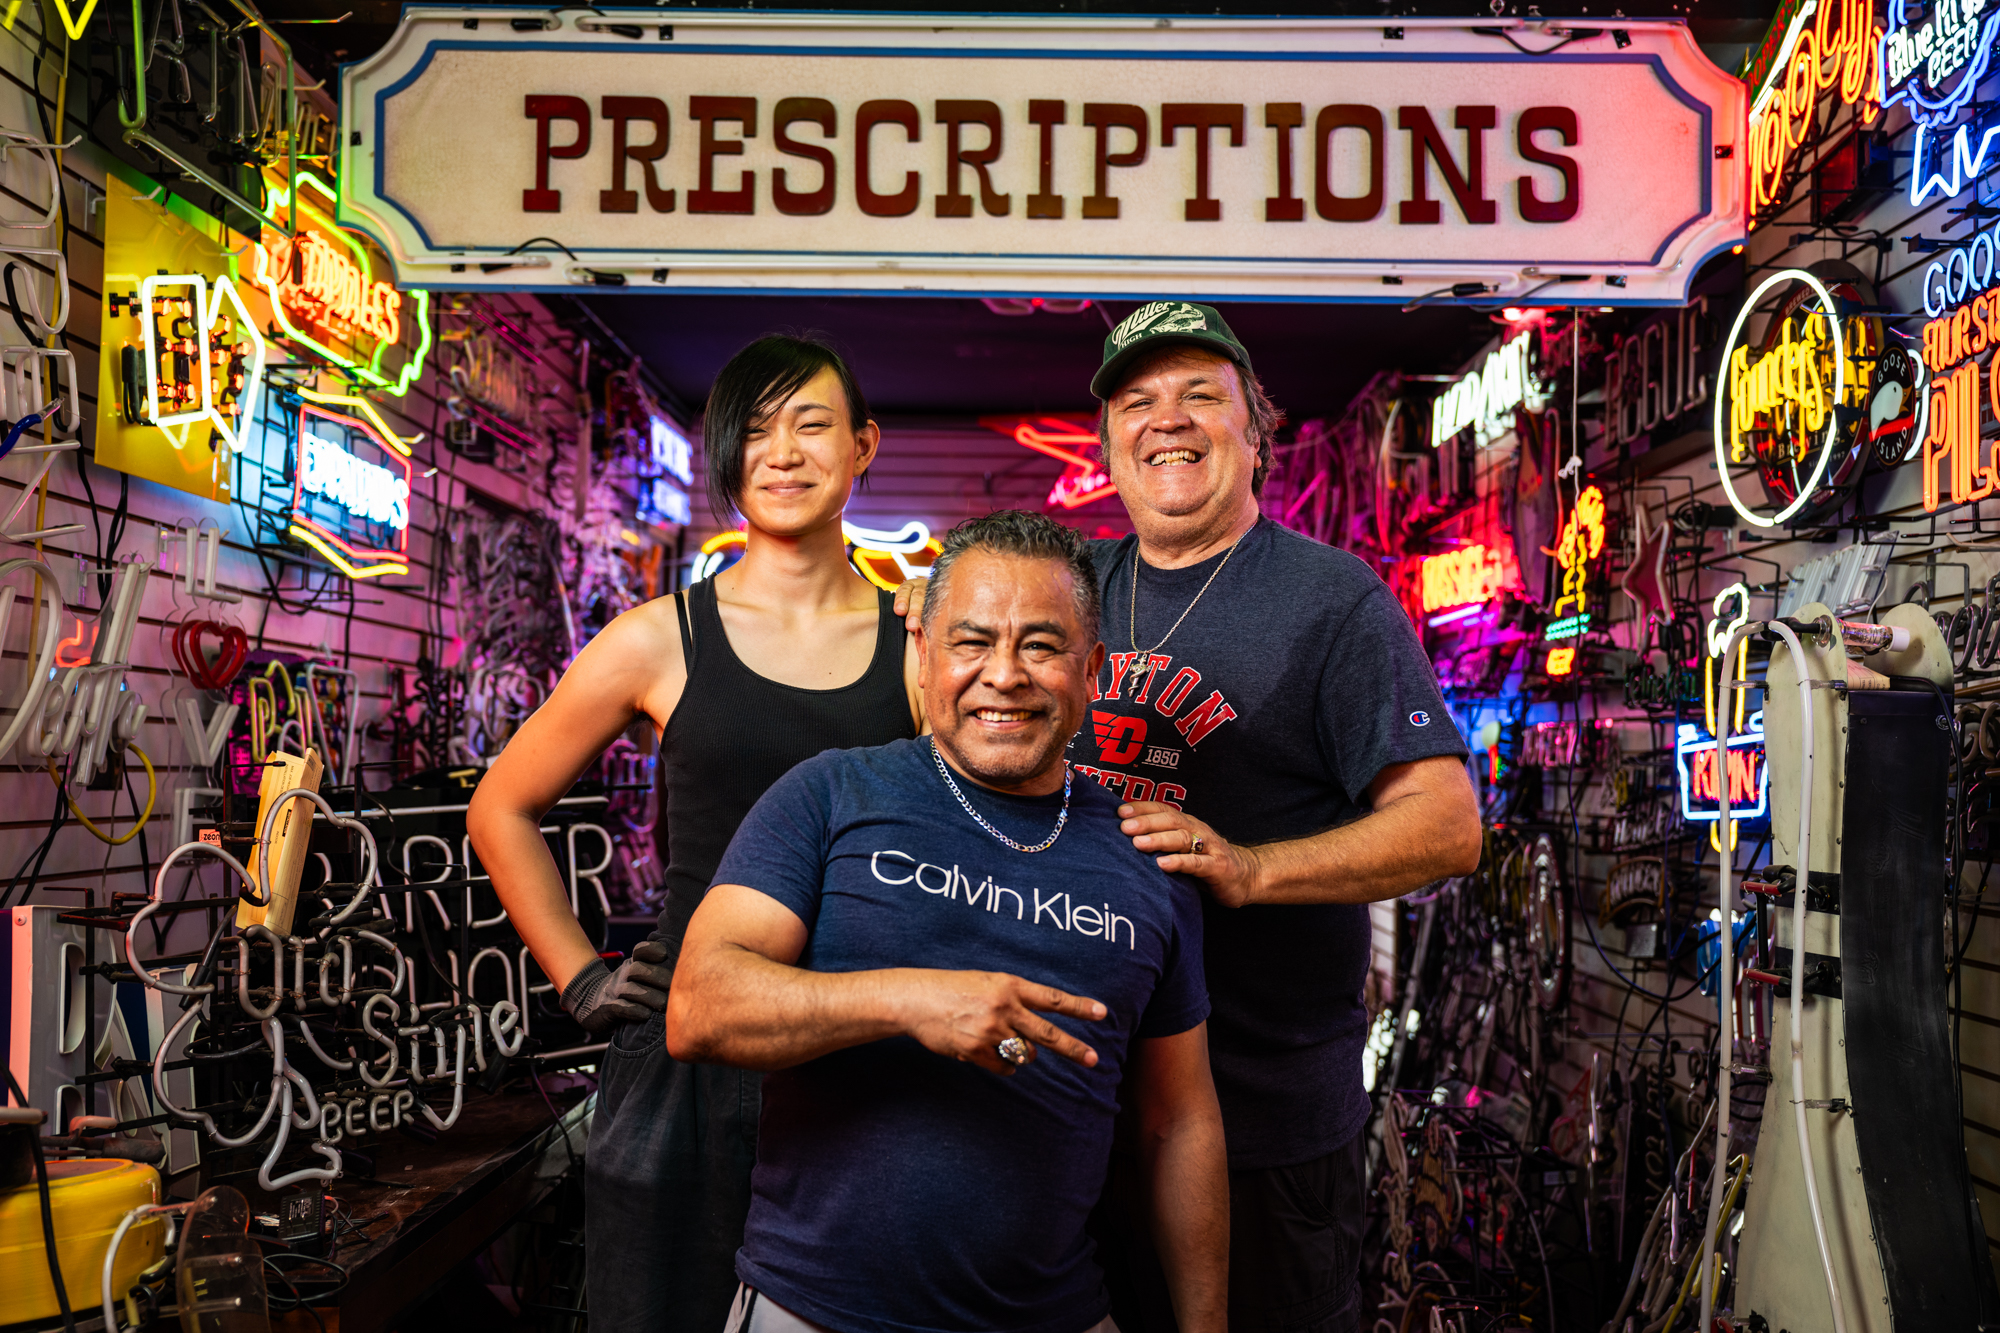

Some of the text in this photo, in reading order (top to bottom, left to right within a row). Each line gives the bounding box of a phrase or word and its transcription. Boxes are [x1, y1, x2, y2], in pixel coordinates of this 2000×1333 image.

[1928, 18, 1978, 88] BEER
[522, 94, 1580, 224] PRESCRIPTIONS
[1112, 301, 1175, 350] Miller
[1121, 333, 1143, 348] HIGH
[1877, 353, 1907, 384] GOOSE
[1876, 426, 1908, 461] ISLAND
[1092, 652, 1238, 747] YTON
[1145, 749, 1180, 767] 1850
[870, 849, 1135, 951] Calvin Klein
[359, 993, 525, 1131] Style
[320, 1088, 415, 1145] BEER
